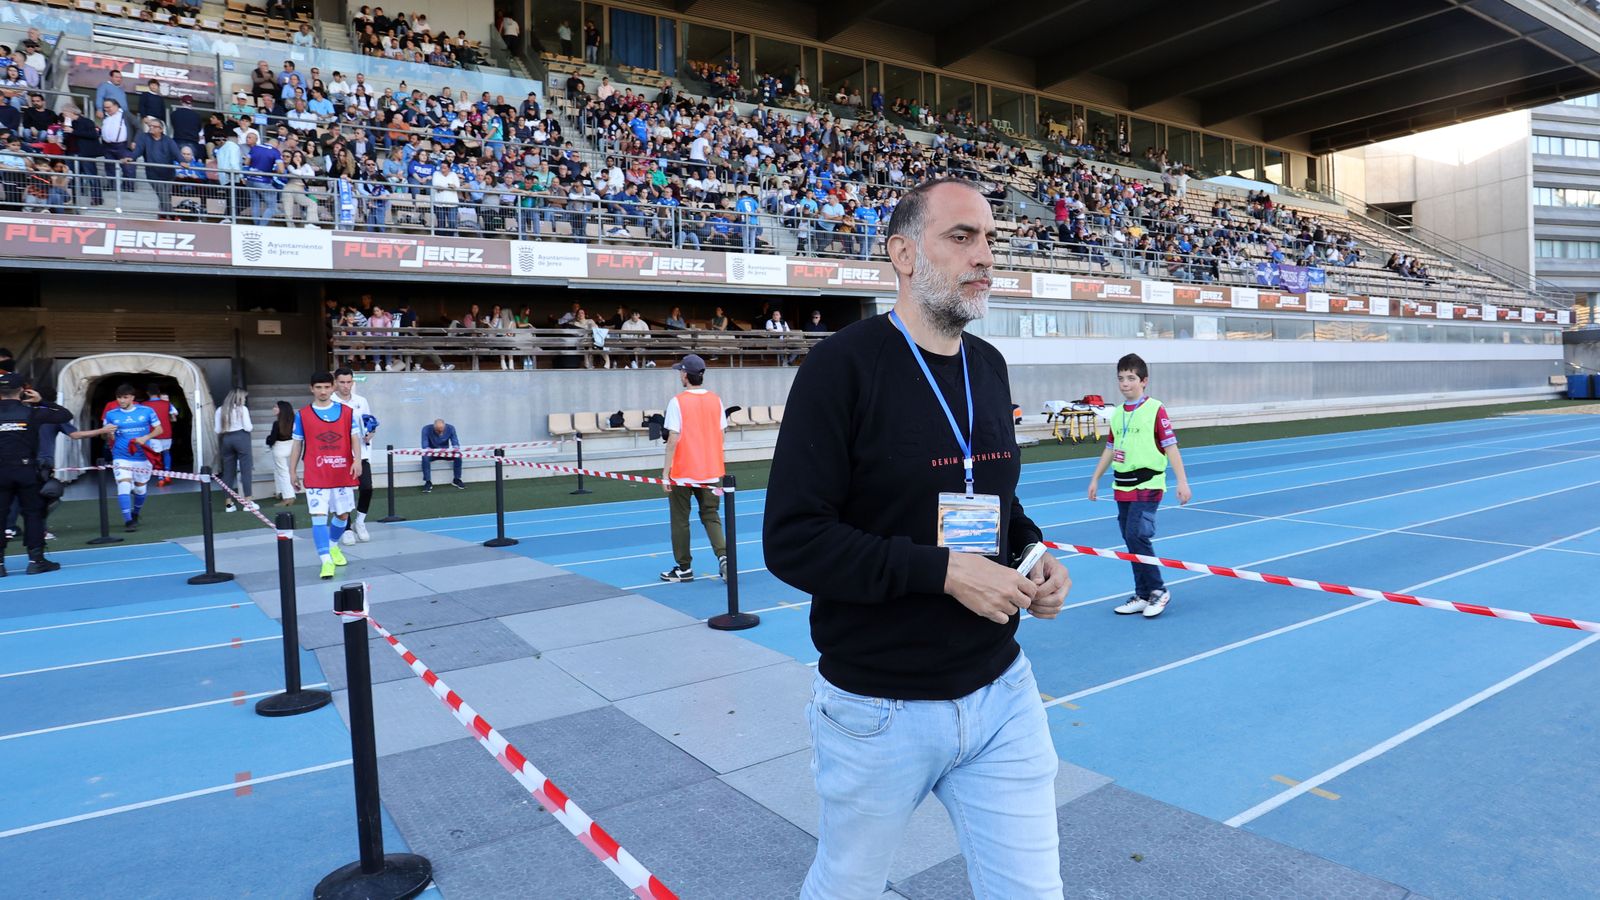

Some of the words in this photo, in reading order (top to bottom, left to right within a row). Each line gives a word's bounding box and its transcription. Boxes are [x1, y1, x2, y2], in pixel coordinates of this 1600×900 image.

[75, 56, 128, 71] PLAY
[121, 57, 189, 80] JEREZ
[5, 224, 96, 244] PLAY
[82, 223, 196, 255] JEREZ
[267, 241, 323, 250] Ayuntamiento
[344, 242, 411, 259] PLAY
[400, 240, 484, 268] JEREZ
[597, 254, 649, 269] PLAY
[639, 252, 706, 276] JEREZ
[794, 265, 835, 278] PLAY
[828, 264, 881, 285] JEREZ
[992, 276, 1020, 289] EREZ
[931, 457, 959, 467] DENIM
[962, 451, 1011, 463] OTHING.CO
